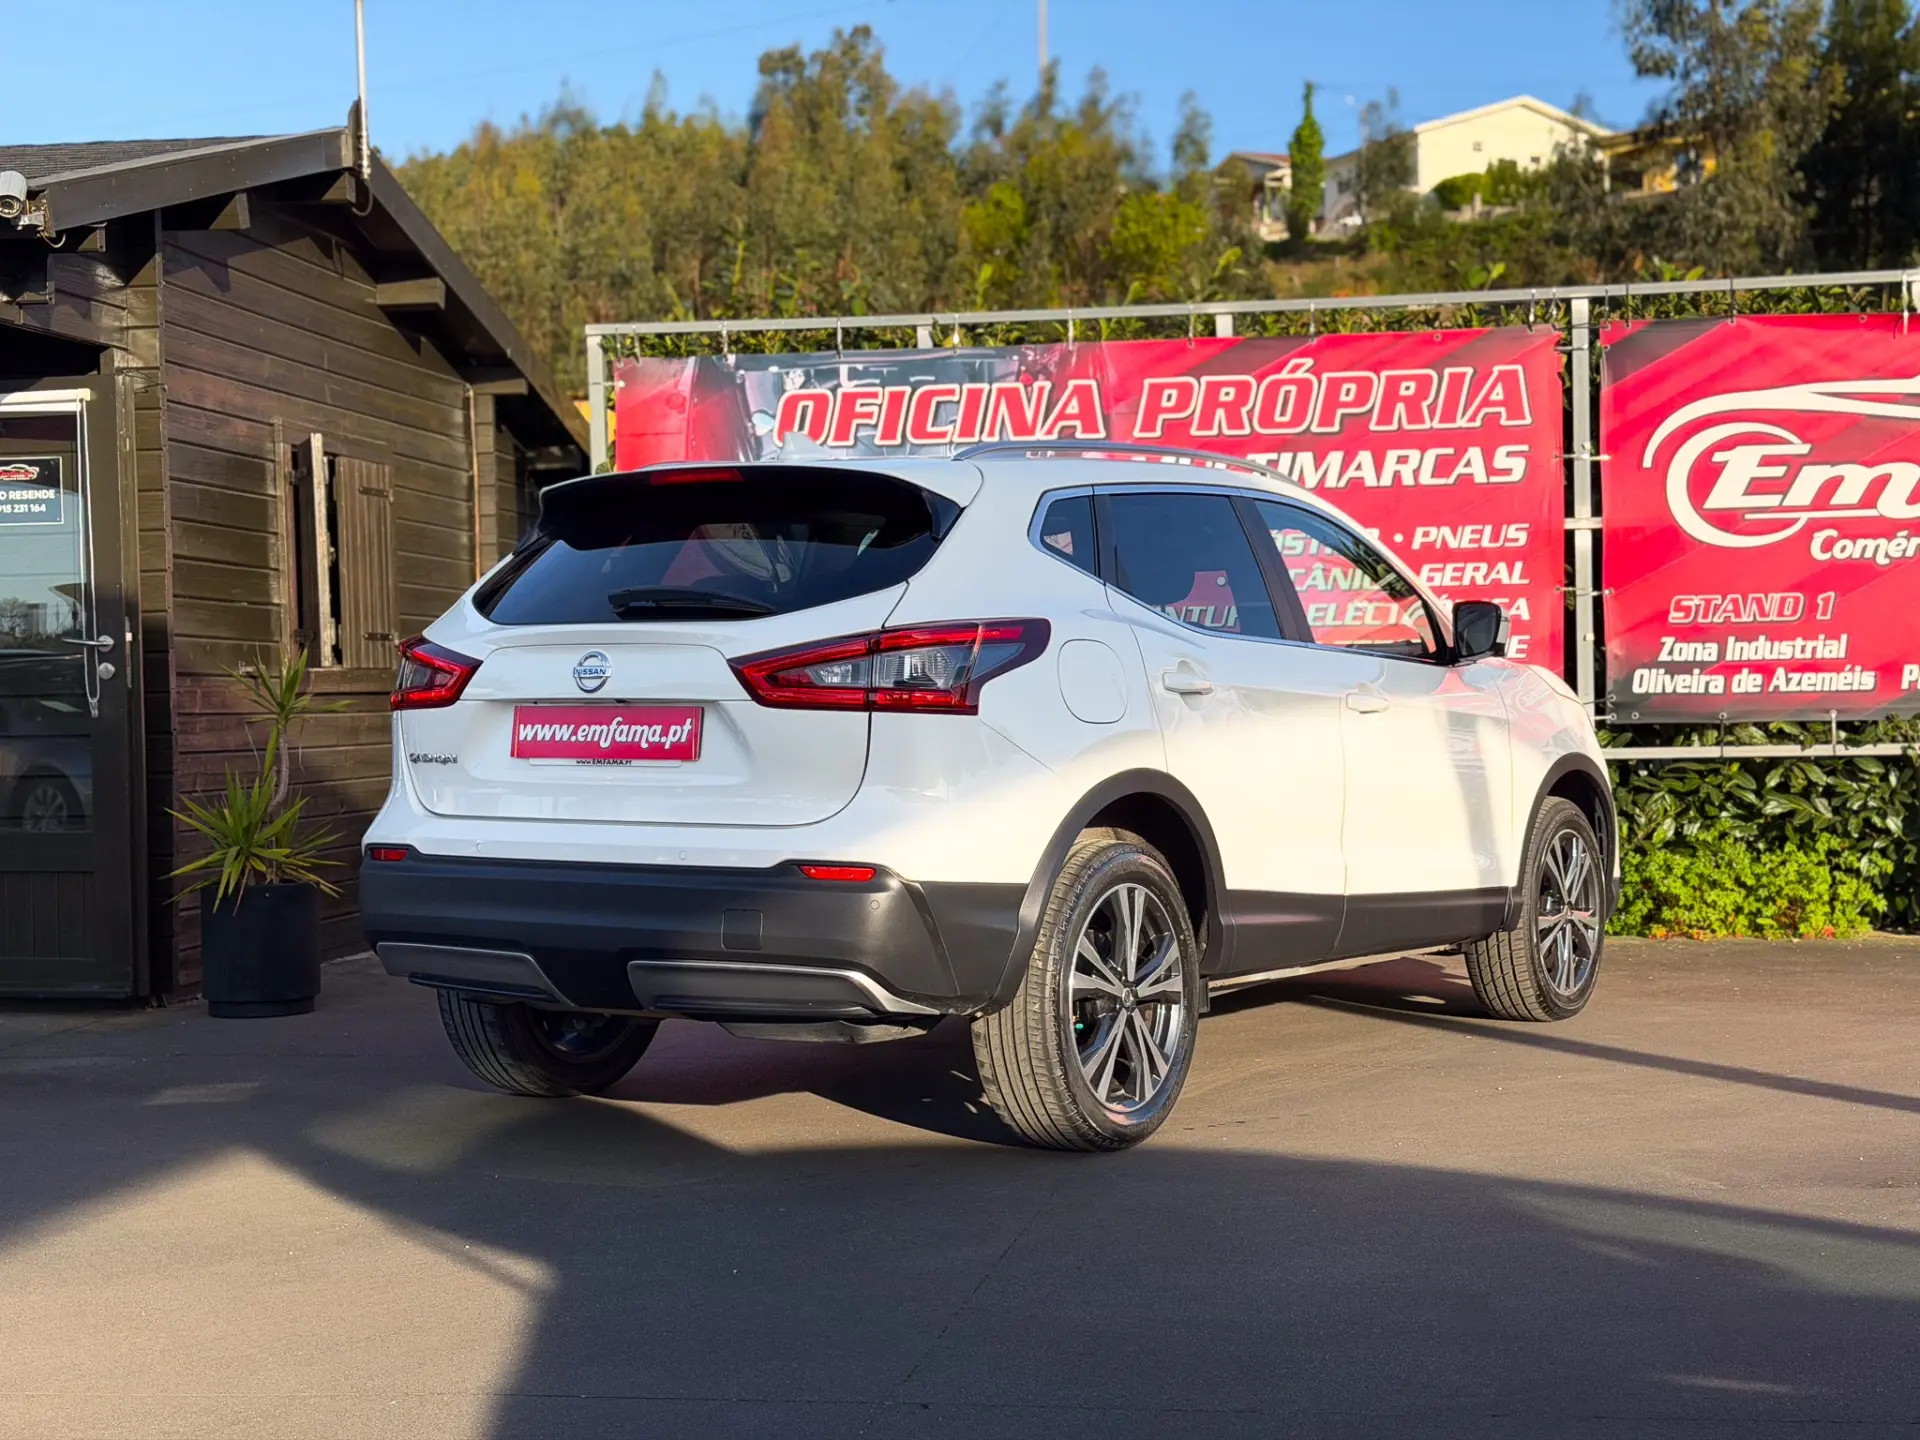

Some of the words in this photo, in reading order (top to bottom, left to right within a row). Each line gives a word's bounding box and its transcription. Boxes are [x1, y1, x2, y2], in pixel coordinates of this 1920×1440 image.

[773, 379, 1106, 447] OFICINA
[1132, 358, 1532, 438] PRÓPRIA
[8, 489, 56, 500] RESENDE
[13, 504, 28, 513] 231
[29, 503, 47, 512] 164
[1411, 523, 1530, 550] PNEUS
[1417, 561, 1531, 587] GERAL
[1668, 592, 1804, 623] STAND
[1815, 592, 1835, 620] 1
[1657, 636, 1720, 662] Zona
[1725, 633, 1848, 660] Industrial
[575, 667, 607, 676] NISSAN
[1632, 667, 1725, 694] Oliveira
[1731, 669, 1762, 693] de
[1767, 664, 1876, 692] Azeméis
[519, 716, 692, 750] www.emfama.pt
